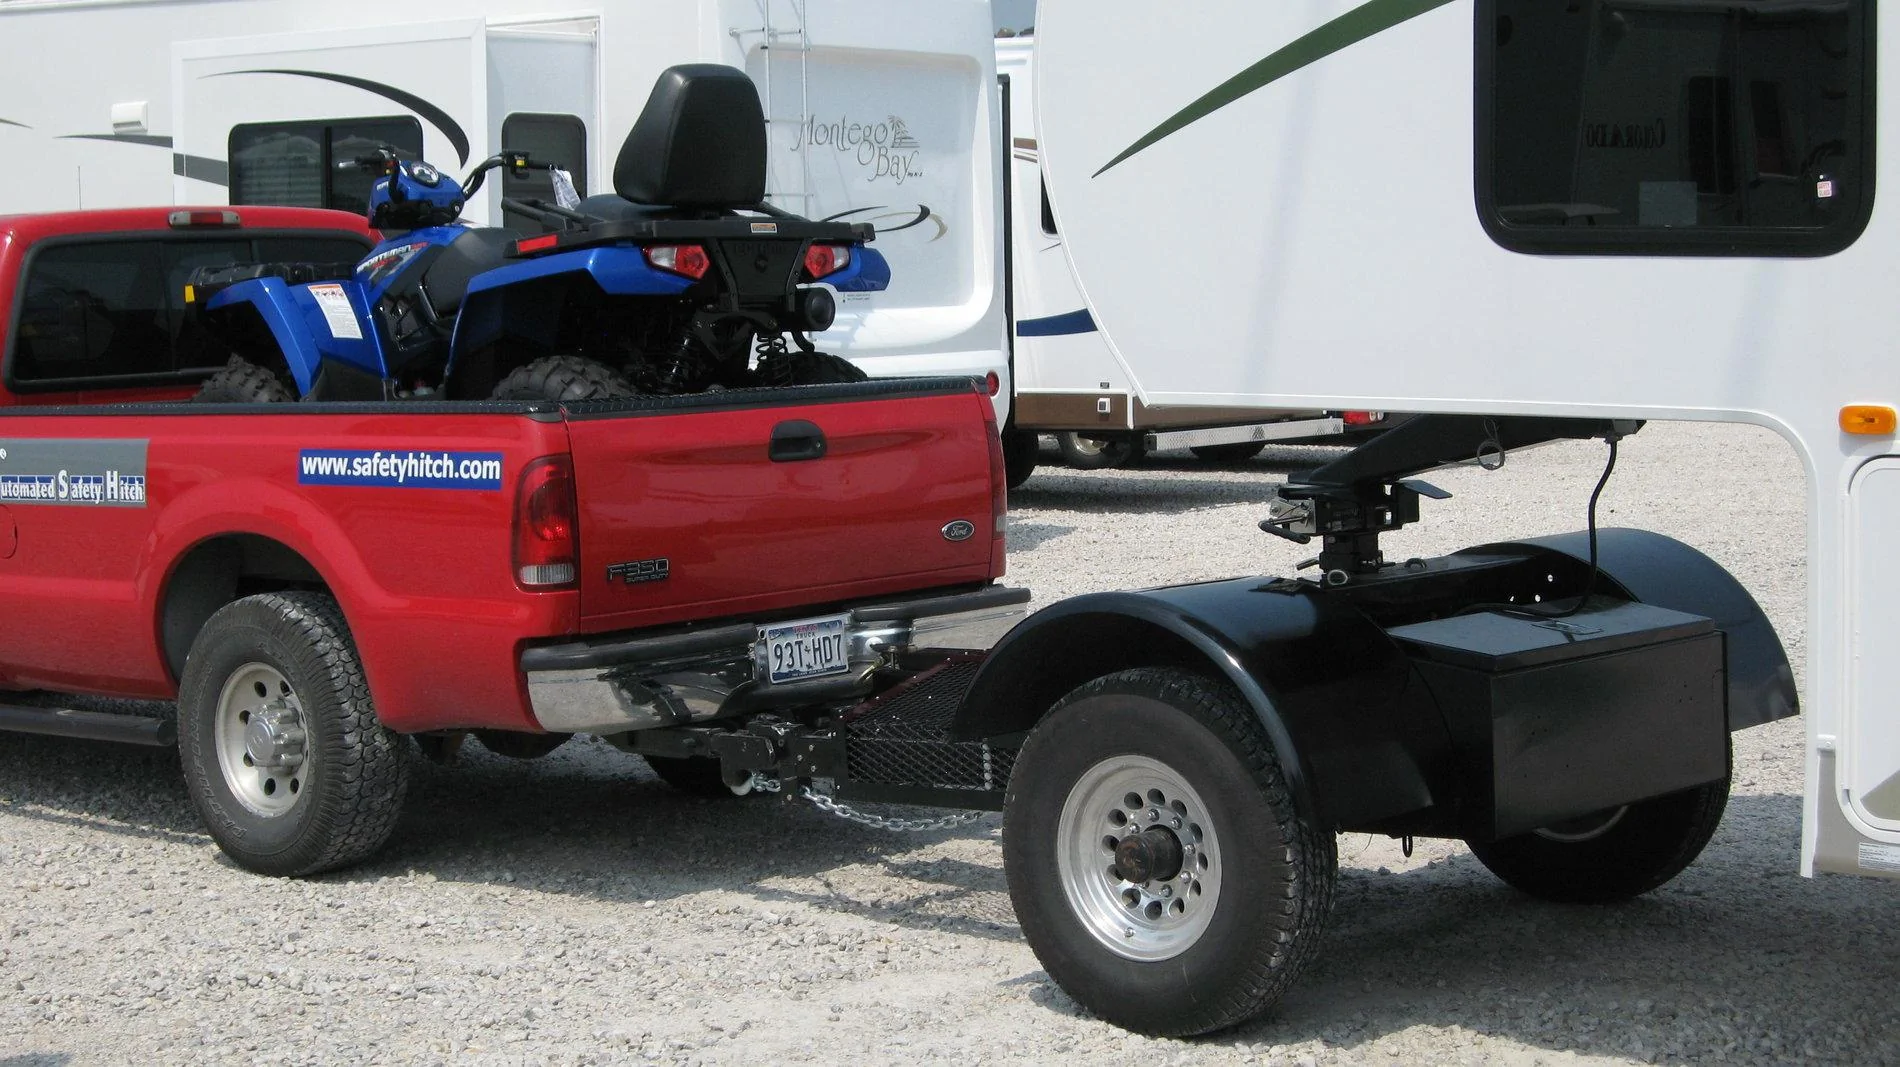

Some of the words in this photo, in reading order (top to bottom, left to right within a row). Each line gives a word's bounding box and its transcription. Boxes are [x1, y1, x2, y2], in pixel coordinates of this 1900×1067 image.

[790, 113, 888, 166] Montego
[867, 145, 920, 186] Bay
[58, 469, 104, 504] Safety
[106, 470, 144, 501] Hitch
[302, 452, 501, 483] www.safetyhitch.com
